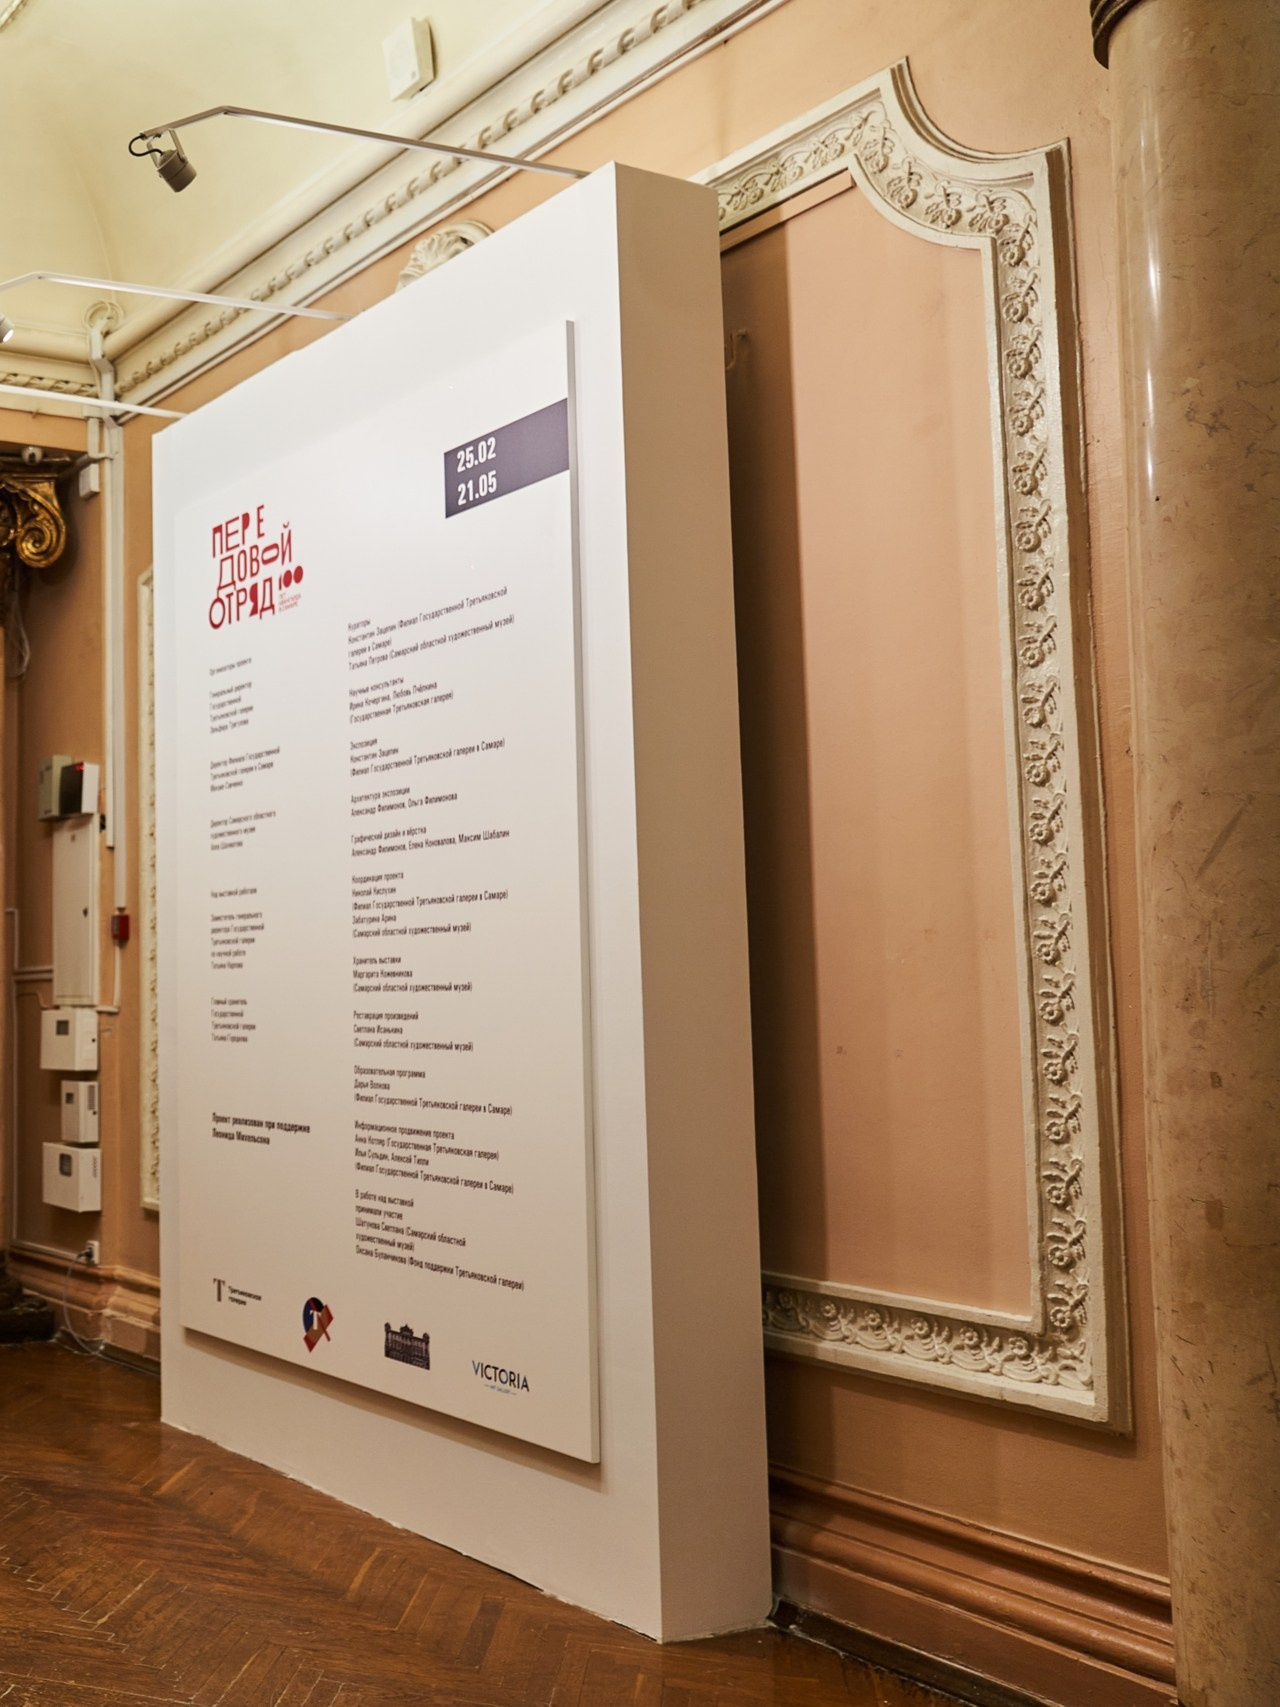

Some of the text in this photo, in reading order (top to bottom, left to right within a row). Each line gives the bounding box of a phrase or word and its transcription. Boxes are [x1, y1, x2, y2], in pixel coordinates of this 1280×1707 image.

[457, 436, 496, 472] 25.02
[458, 470, 497, 505] 21.05
[209, 577, 275, 630] ОТРЯД
[212, 1112, 310, 1133] Проект реализован при поддержке
[212, 1128, 270, 1145] Леонида Михельсона
[472, 1360, 529, 1392] VICTORIA
